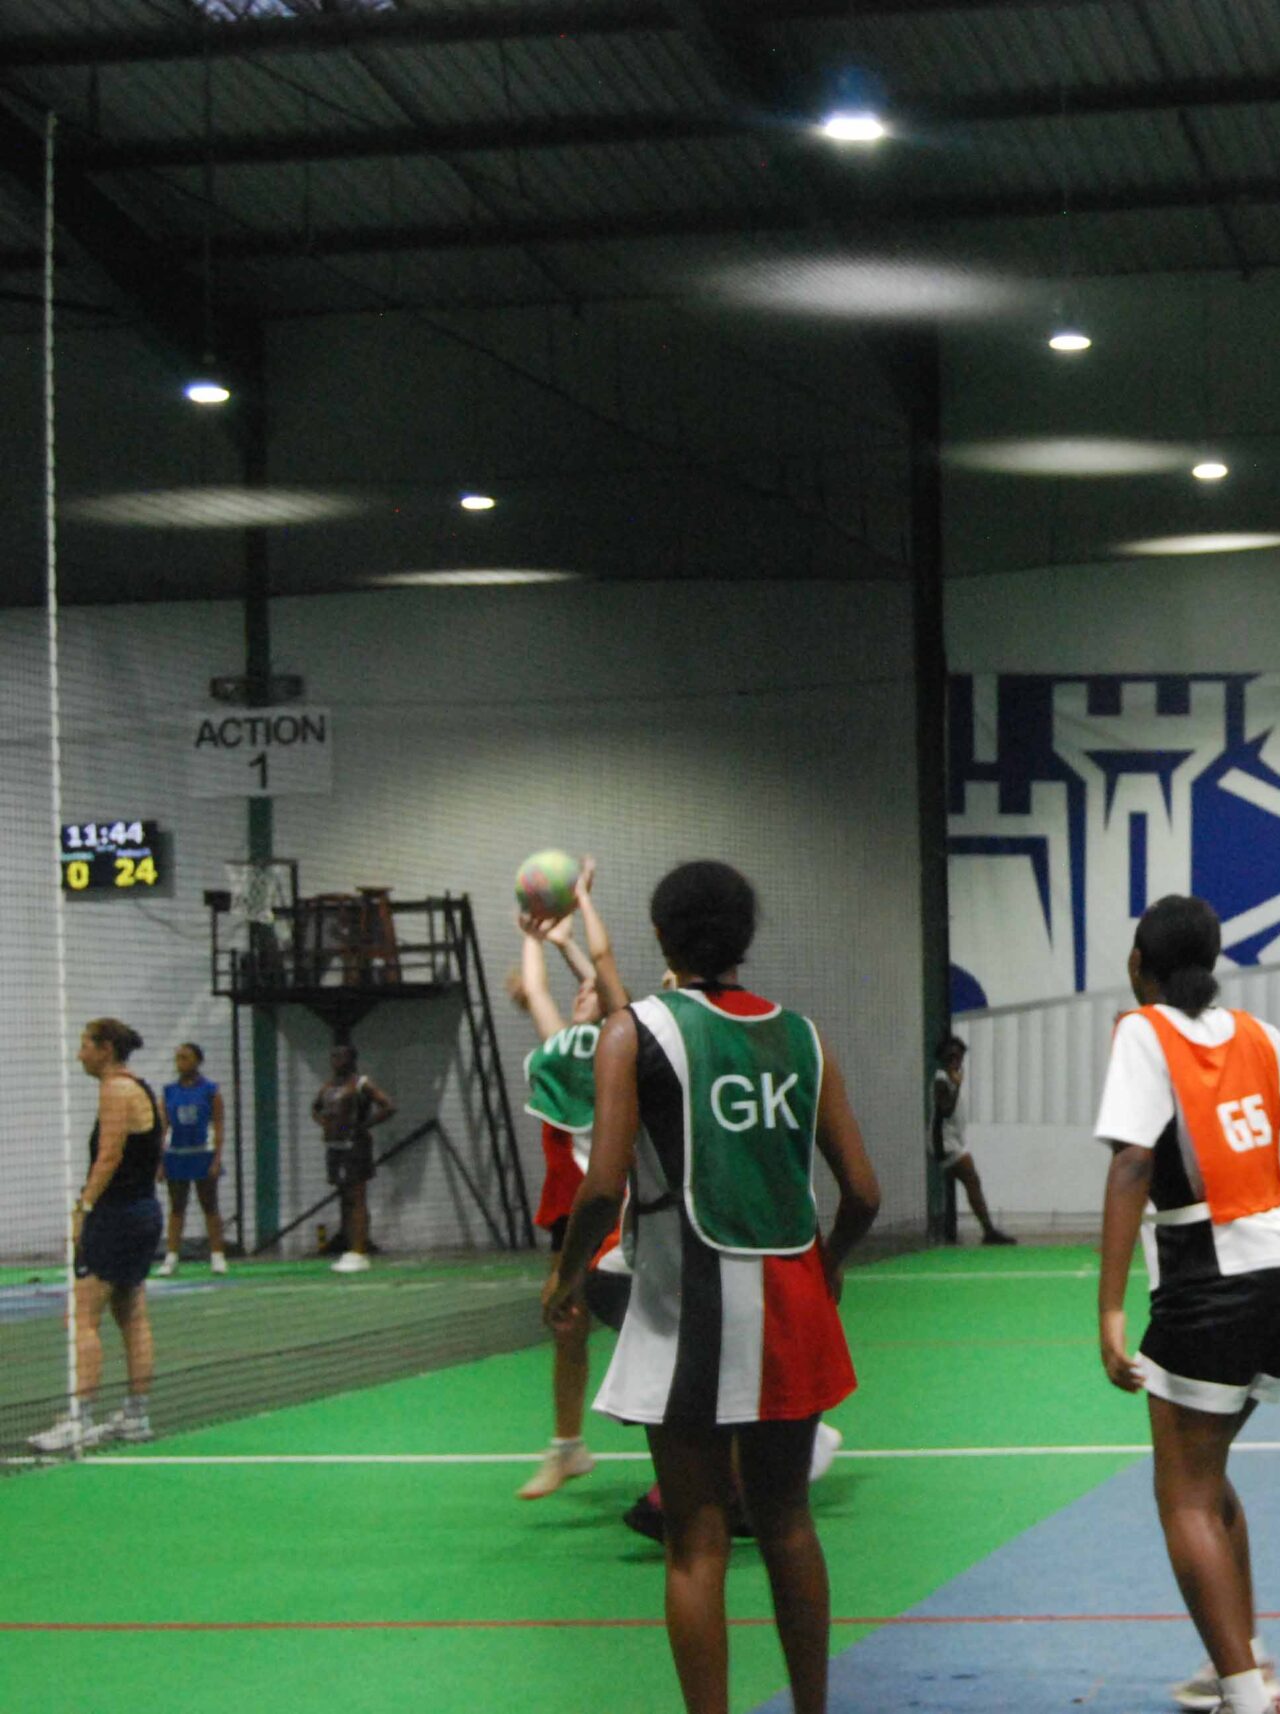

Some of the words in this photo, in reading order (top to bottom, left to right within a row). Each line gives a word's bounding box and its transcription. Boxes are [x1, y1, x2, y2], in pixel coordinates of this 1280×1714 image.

[194, 714, 326, 749] ACTION
[248, 751, 268, 790] 1
[67, 820, 145, 848] 11:44
[67, 860, 90, 890] 0
[114, 856, 159, 888] 24
[710, 1072, 801, 1133] GK
[1216, 1093, 1273, 1153] GS
